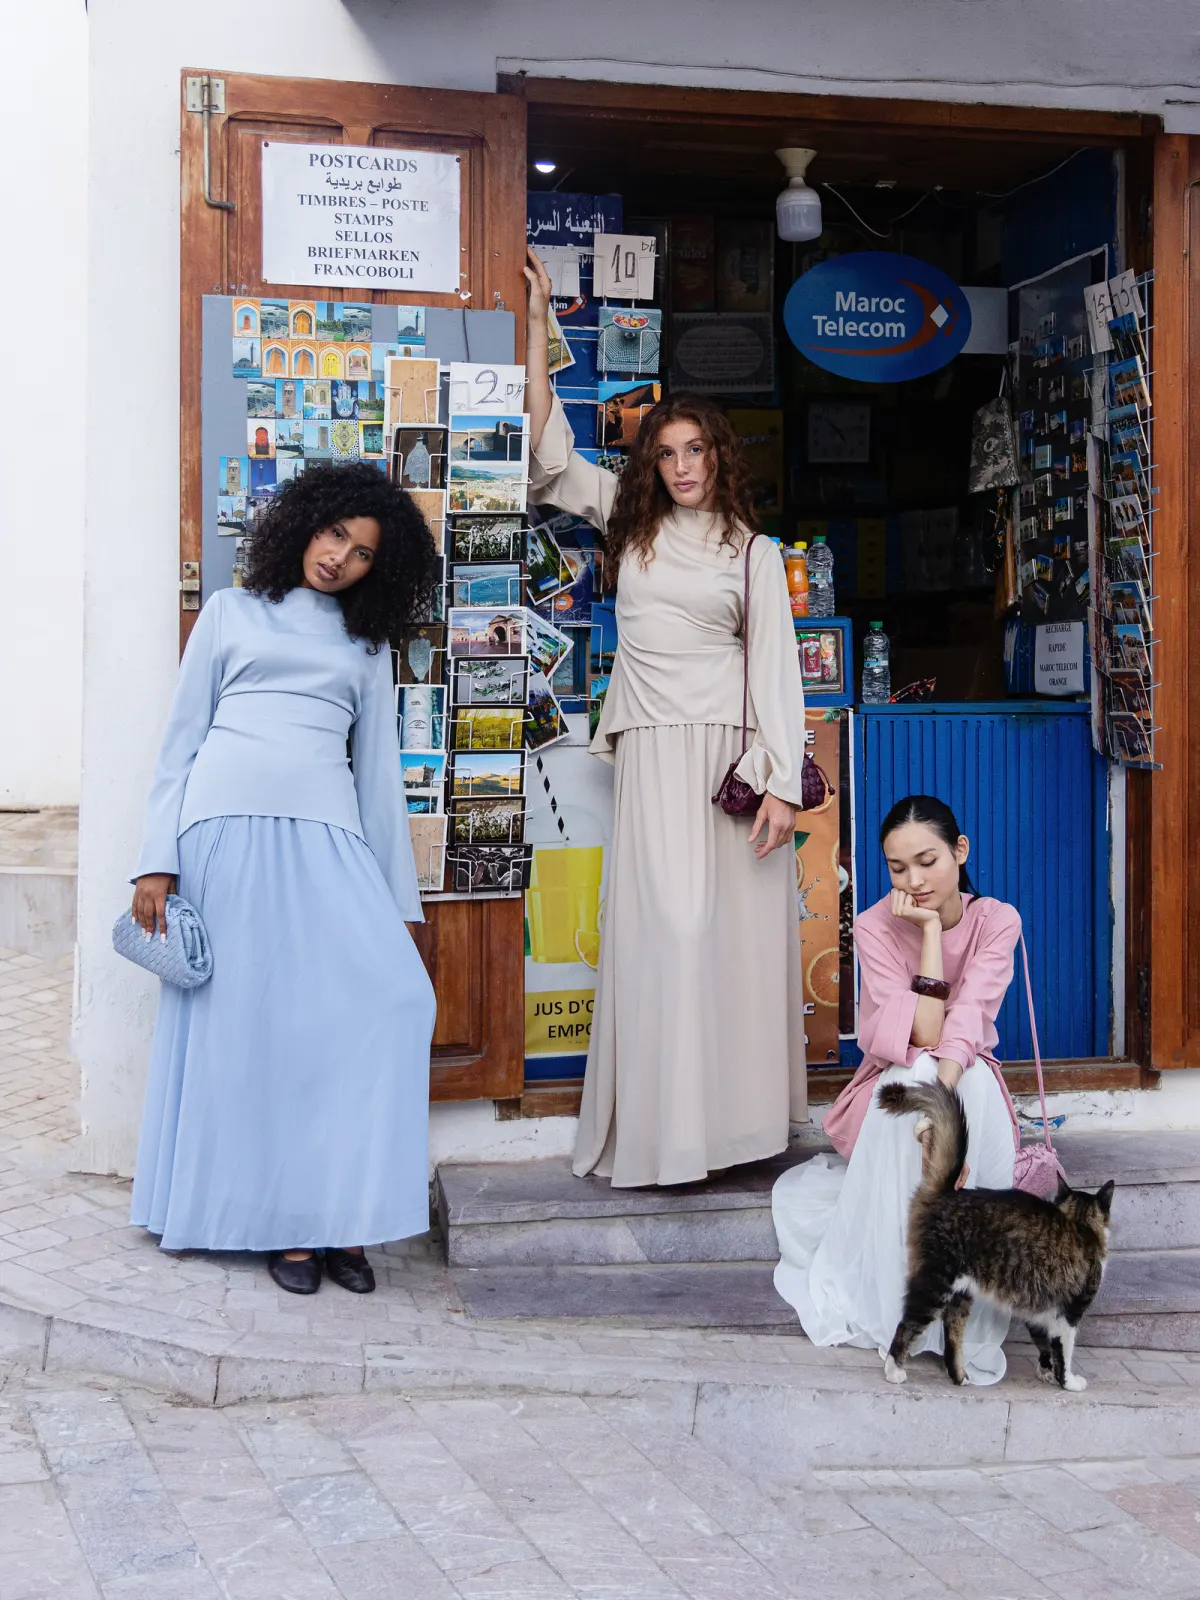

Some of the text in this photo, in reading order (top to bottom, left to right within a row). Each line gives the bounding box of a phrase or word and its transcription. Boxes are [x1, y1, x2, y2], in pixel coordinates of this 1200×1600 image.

[308, 153, 418, 173] POSTCARDS
[325, 172, 402, 194] طوابع بريدية
[297, 194, 366, 209] TIMBRES
[382, 199, 429, 212] POSTE
[334, 213, 394, 227] STAMPS
[565, 206, 605, 239] التعبئة
[335, 230, 393, 244] SELLOS
[307, 246, 420, 262] BRIEFMARKEN
[314, 263, 414, 279] FRANCOBOLI
[610, 244, 636, 283] 10
[835, 291, 905, 314] Maroc
[1092, 293, 1106, 320] 15
[812, 315, 905, 338] Telecom
[475, 369, 504, 405] 2
[1046, 623, 1071, 633] RECHARGE
[1048, 643, 1066, 652] RAPIDE
[1039, 662, 1078, 672] MAROC TELECOM
[1049, 677, 1067, 685] ORANGE
[534, 999, 595, 1016] JUS D'O
[548, 1023, 592, 1038] EMP
